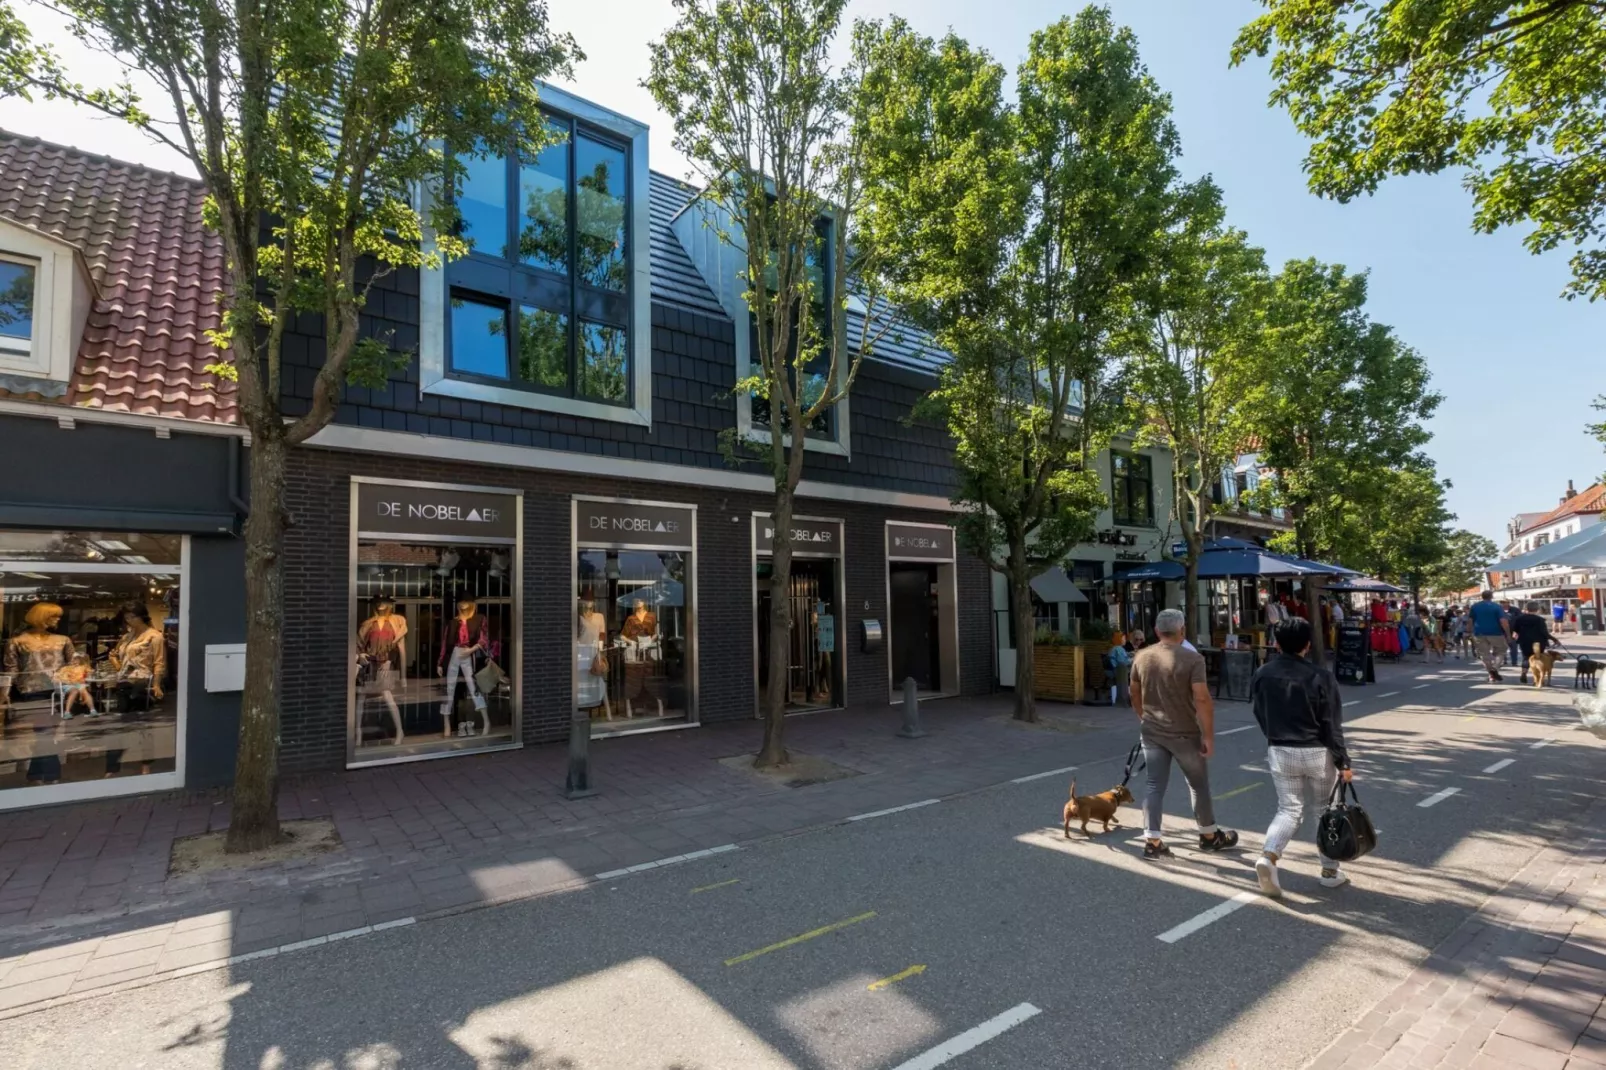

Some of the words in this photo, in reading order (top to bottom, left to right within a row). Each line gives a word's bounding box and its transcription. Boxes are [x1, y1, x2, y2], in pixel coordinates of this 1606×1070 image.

[377, 501, 401, 518] DE
[589, 515, 608, 530] DE
[788, 528, 833, 543] OBELAER
